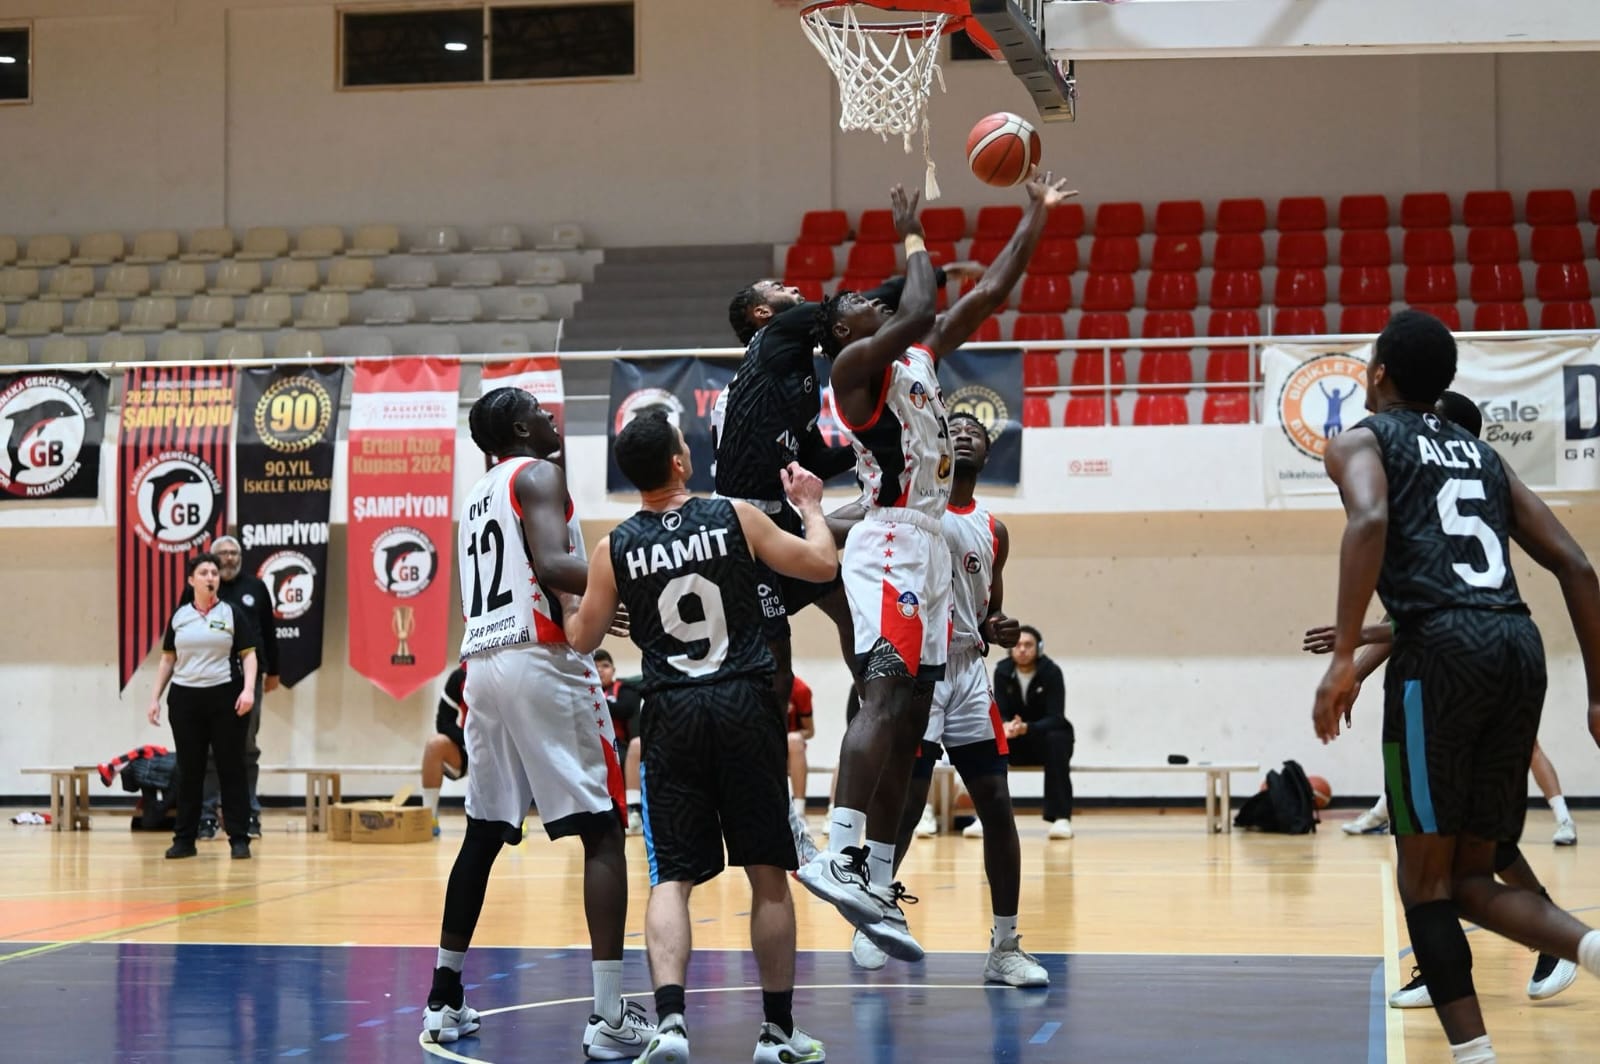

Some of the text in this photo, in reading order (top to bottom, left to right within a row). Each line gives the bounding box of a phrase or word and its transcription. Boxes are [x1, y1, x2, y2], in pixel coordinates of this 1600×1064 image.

[123, 404, 232, 432] ŞAMPİYONU
[270, 393, 317, 432] 90
[1486, 424, 1533, 447] Boya
[30, 440, 64, 468] GB
[411, 455, 451, 474] 2024
[265, 461, 313, 477] 90.YIL
[244, 478, 285, 493] İSKELE
[171, 503, 201, 526] GB
[353, 492, 449, 522] ŞAMPİYON
[242, 519, 329, 550] ŞAMPİYON
[1436, 478, 1506, 589] 5
[626, 525, 729, 581] HAMİT
[399, 566, 420, 581] GB
[467, 519, 513, 618] 12
[285, 588, 304, 603] GB
[766, 604, 786, 618] Bus
[275, 627, 300, 639] 2024
[657, 572, 730, 678] 9
